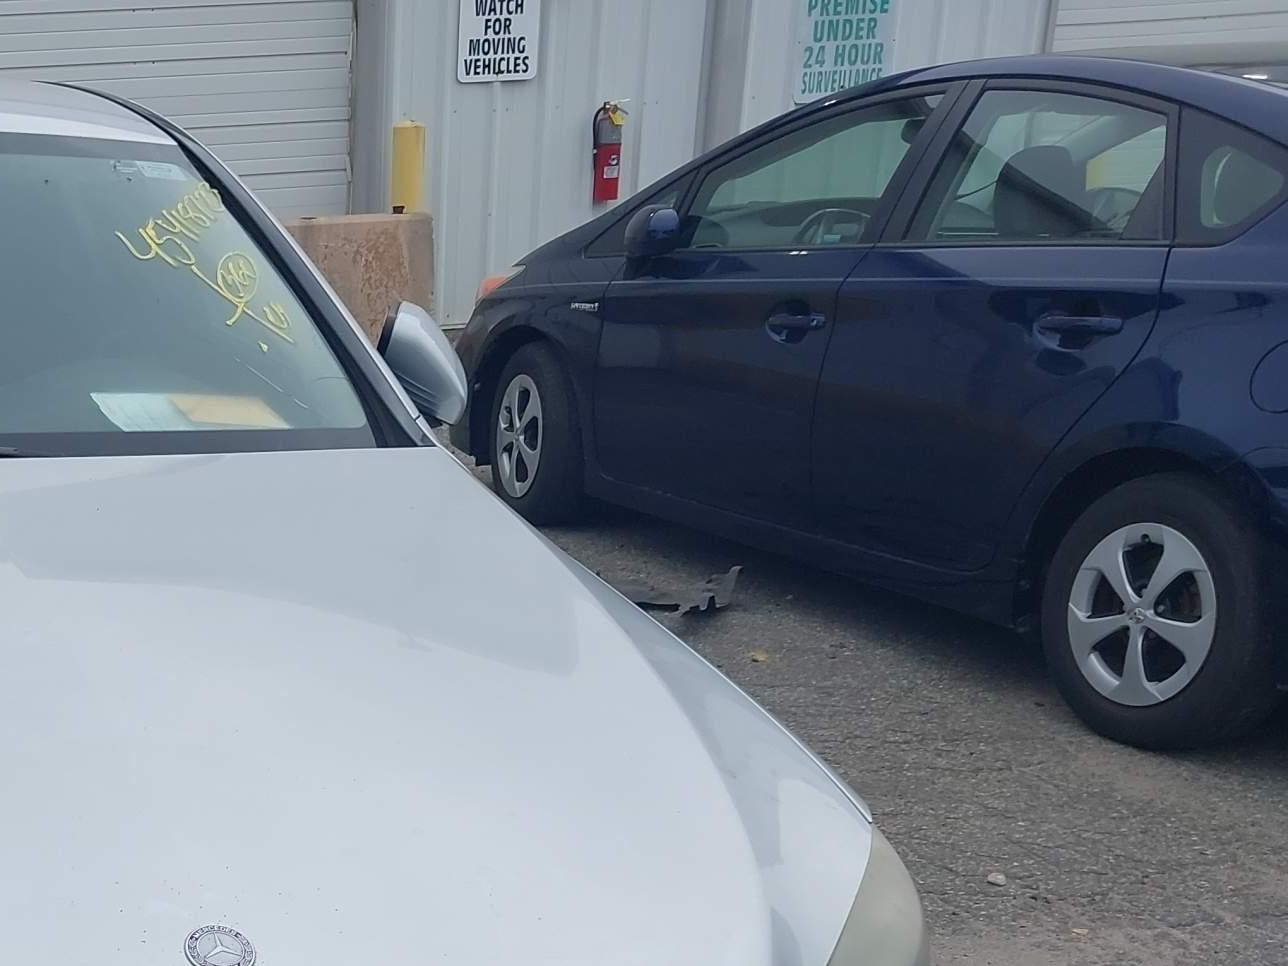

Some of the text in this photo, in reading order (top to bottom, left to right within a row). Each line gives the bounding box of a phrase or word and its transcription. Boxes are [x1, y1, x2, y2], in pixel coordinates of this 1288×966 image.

[474, 0, 524, 16] WATCH
[807, 0, 889, 17] PREMISE
[484, 18, 512, 36] FOR
[813, 17, 877, 42] UNDER
[468, 36, 526, 56] MOVING
[802, 42, 884, 69] 24 HOUR
[463, 56, 530, 76] VEHICLES
